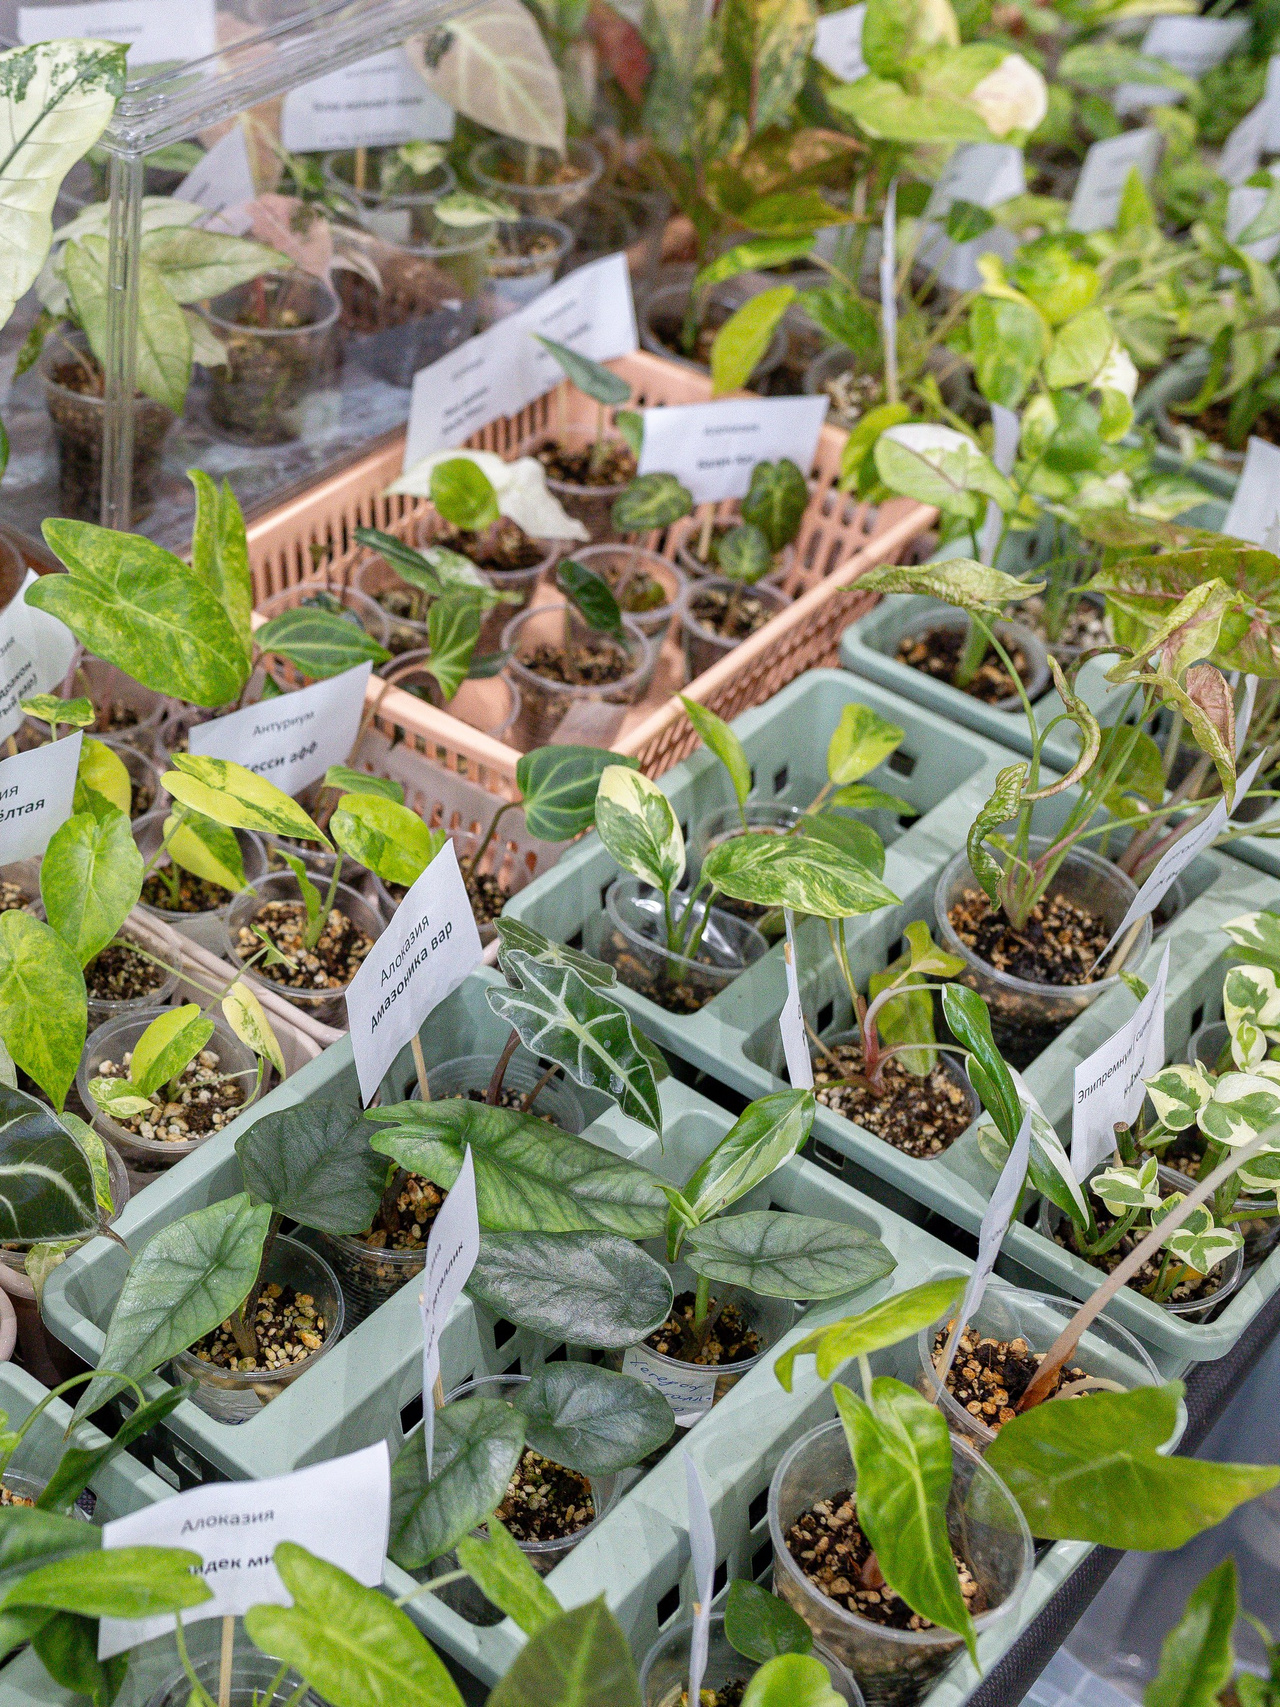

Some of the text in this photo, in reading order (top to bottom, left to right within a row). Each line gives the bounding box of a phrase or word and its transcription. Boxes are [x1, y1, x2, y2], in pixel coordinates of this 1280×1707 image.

[252, 711, 315, 738] Антуриум
[380, 914, 430, 988] Алоказия
[371, 921, 453, 1034] Амазоника вар
[181, 1509, 275, 1536] Алоказия
